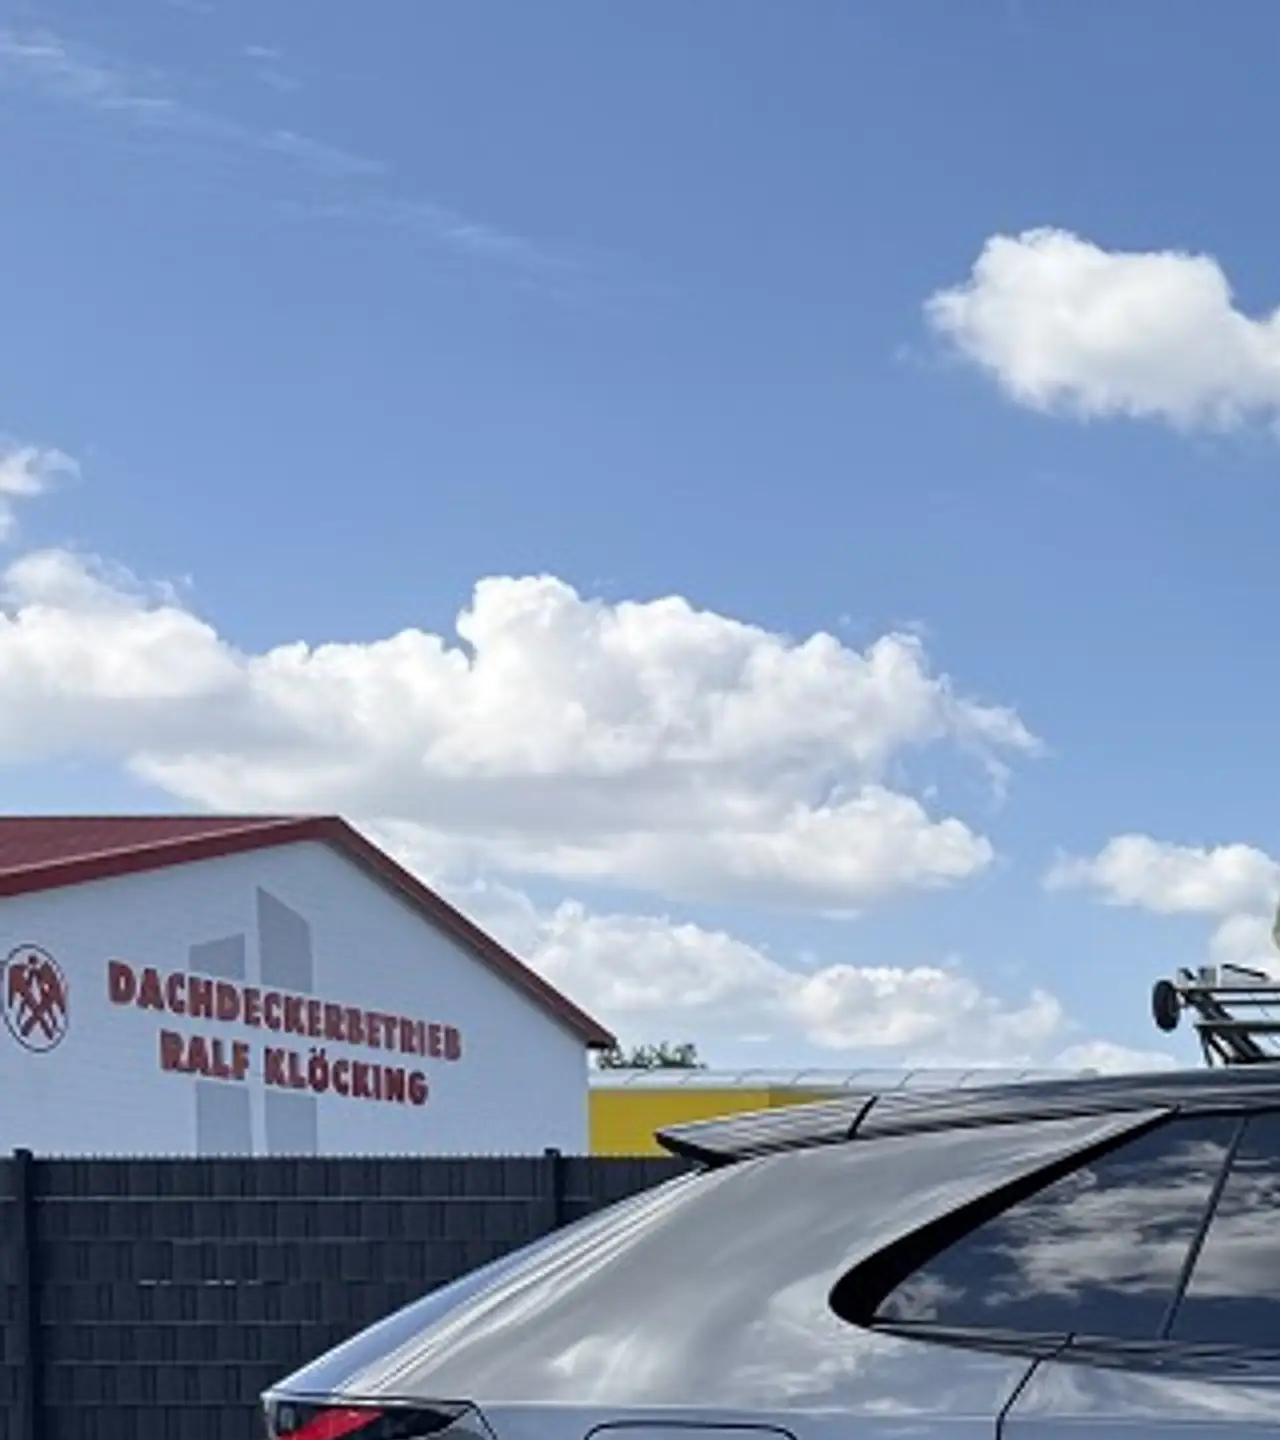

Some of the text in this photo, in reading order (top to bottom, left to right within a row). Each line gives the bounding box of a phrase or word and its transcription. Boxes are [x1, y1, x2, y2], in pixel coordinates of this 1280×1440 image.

[107, 960, 462, 1061] DACHDECKERBETRIEB
[159, 1029, 429, 1106] RALF KLÖCKING
